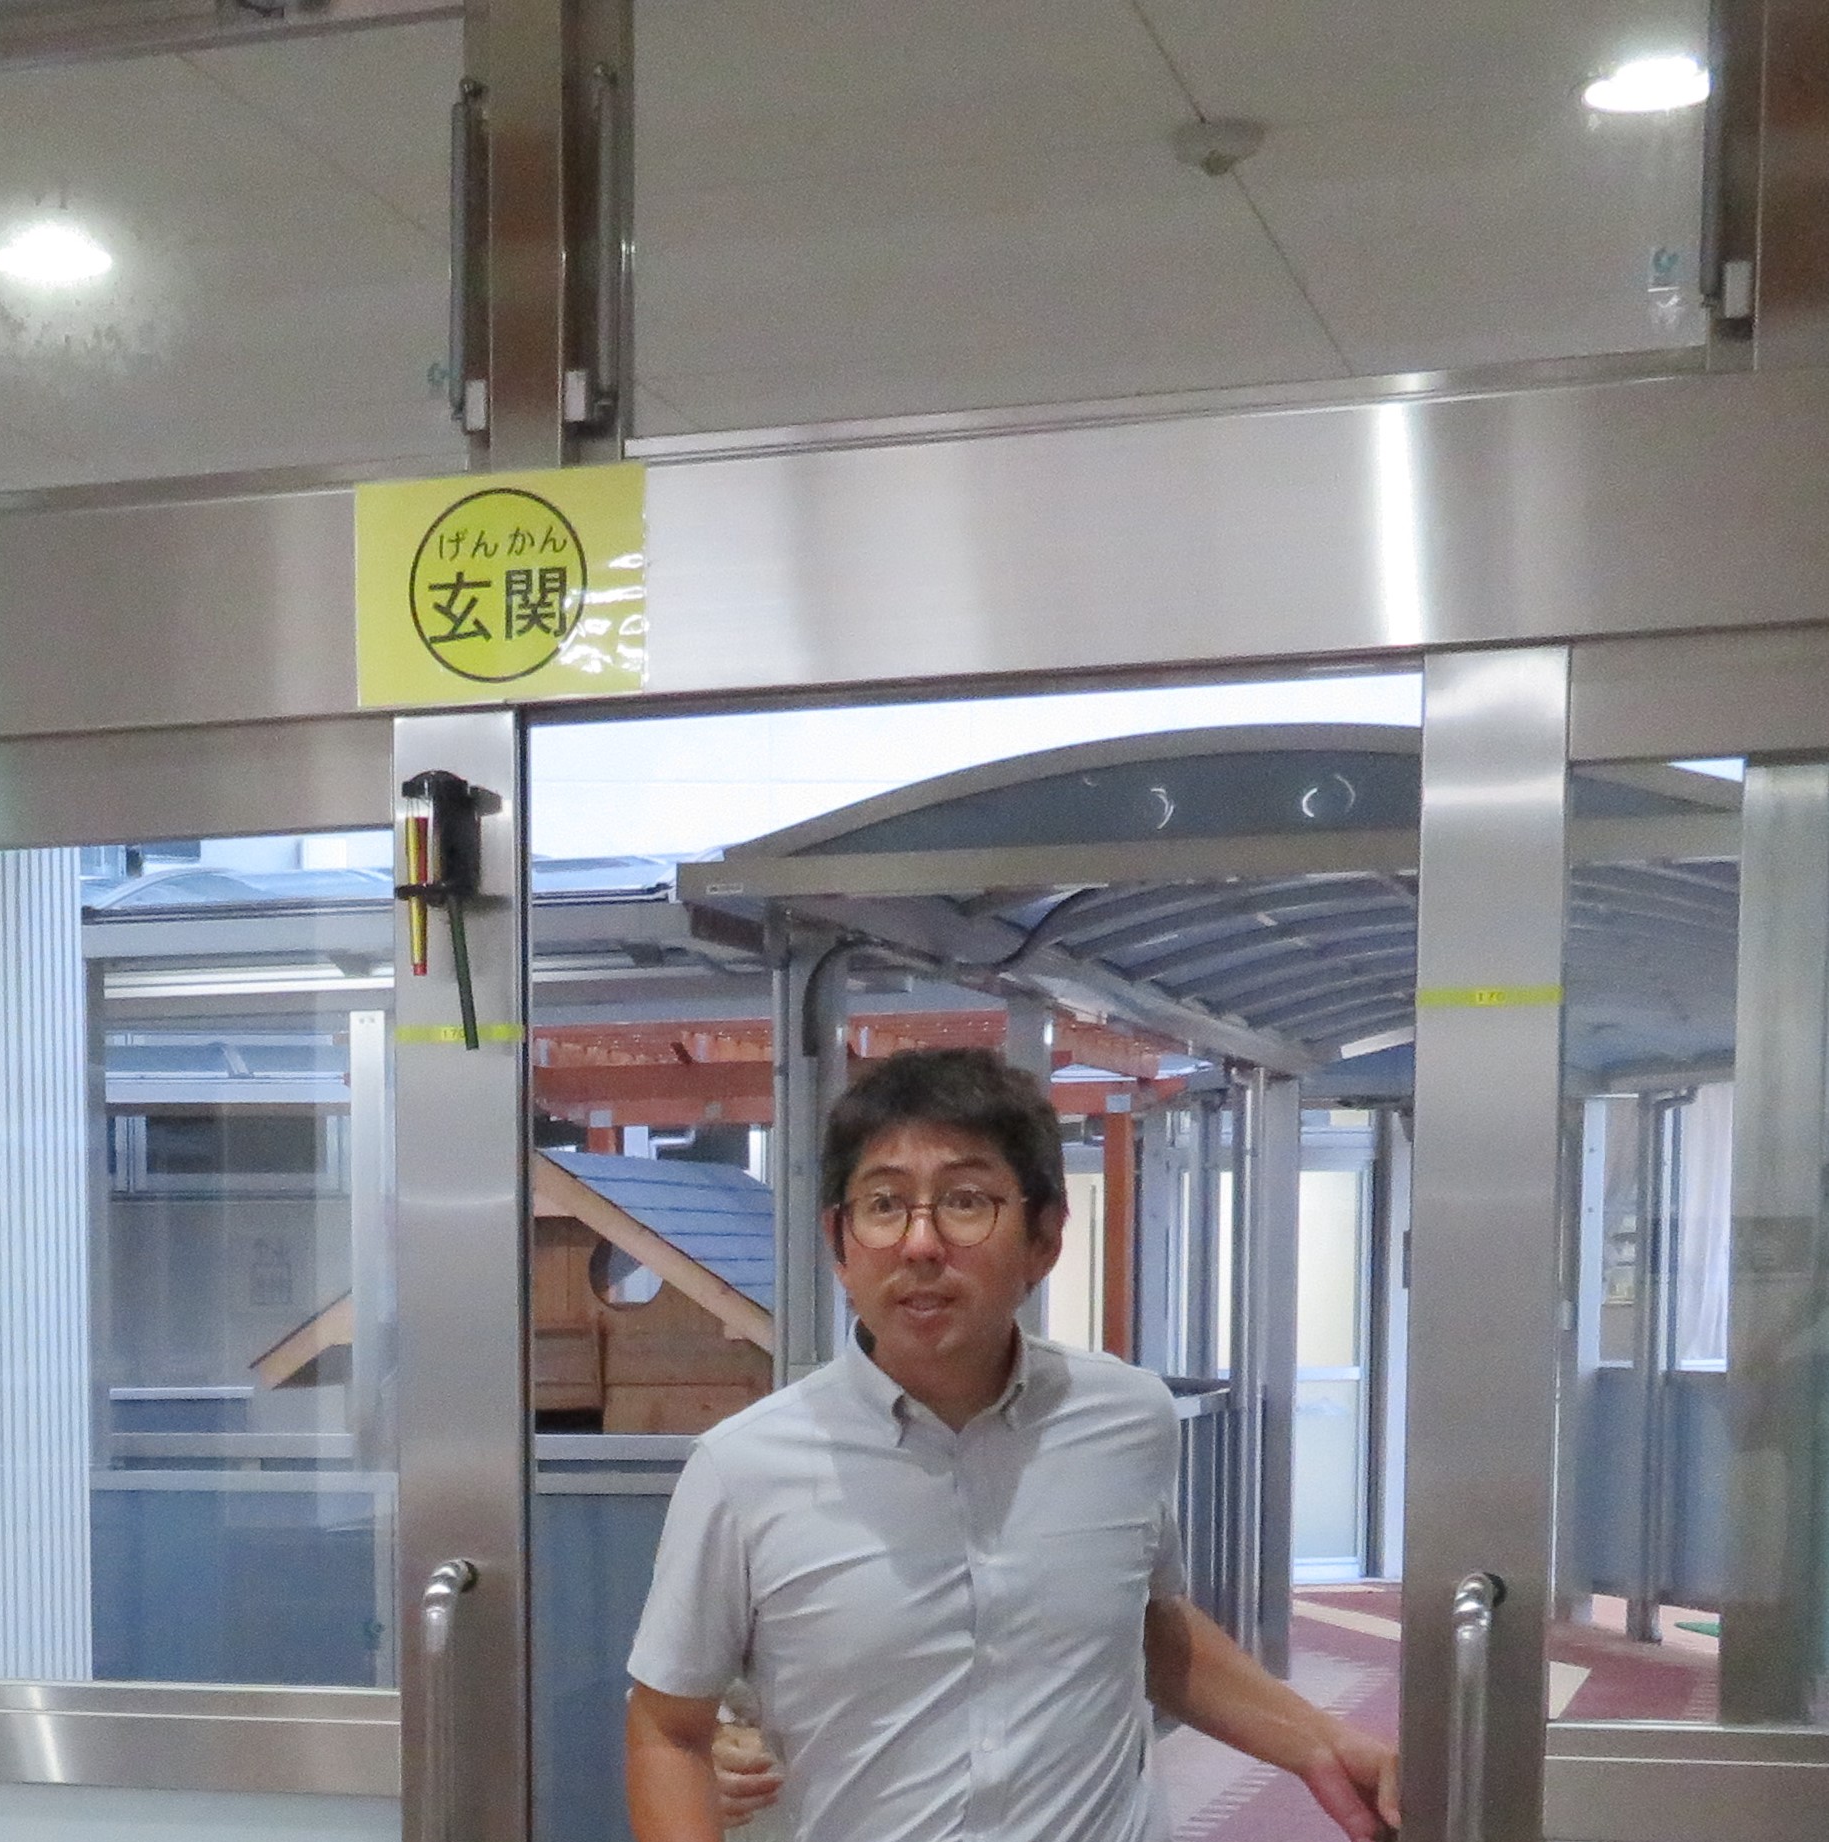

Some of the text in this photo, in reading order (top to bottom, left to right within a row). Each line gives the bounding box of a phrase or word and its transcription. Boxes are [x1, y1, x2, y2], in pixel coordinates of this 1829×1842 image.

[439, 526, 568, 560] げんかん
[428, 566, 568, 644] 玄関
